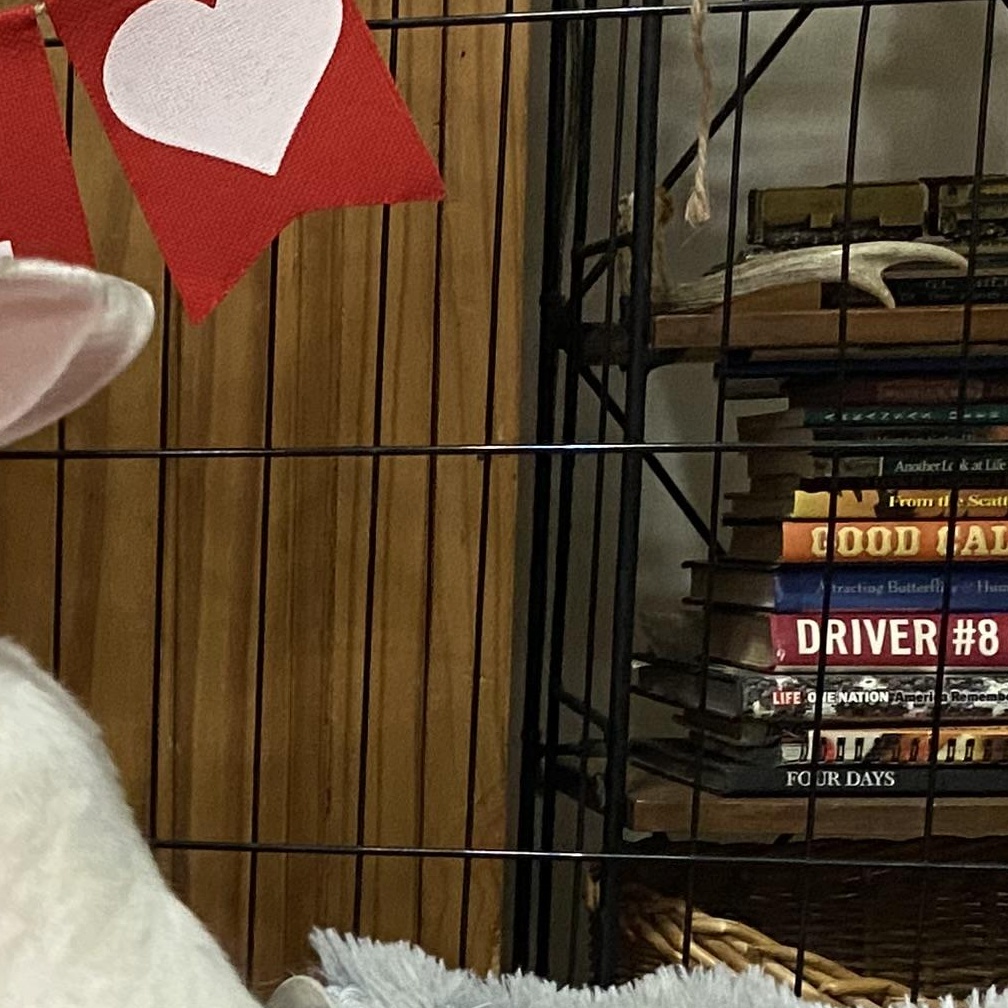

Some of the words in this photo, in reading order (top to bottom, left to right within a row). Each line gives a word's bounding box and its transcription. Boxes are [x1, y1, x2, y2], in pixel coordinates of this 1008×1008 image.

[888, 495, 934, 508] From
[938, 495, 964, 508] th
[811, 525, 922, 558] GOOD
[796, 618, 939, 656] DRIVER
[952, 618, 1000, 657] #8
[772, 691, 802, 706] LIFE
[838, 691, 889, 704] NATION
[896, 690, 949, 703] Ameria
[785, 771, 842, 787] FOUR
[845, 771, 896, 787] DAYS
